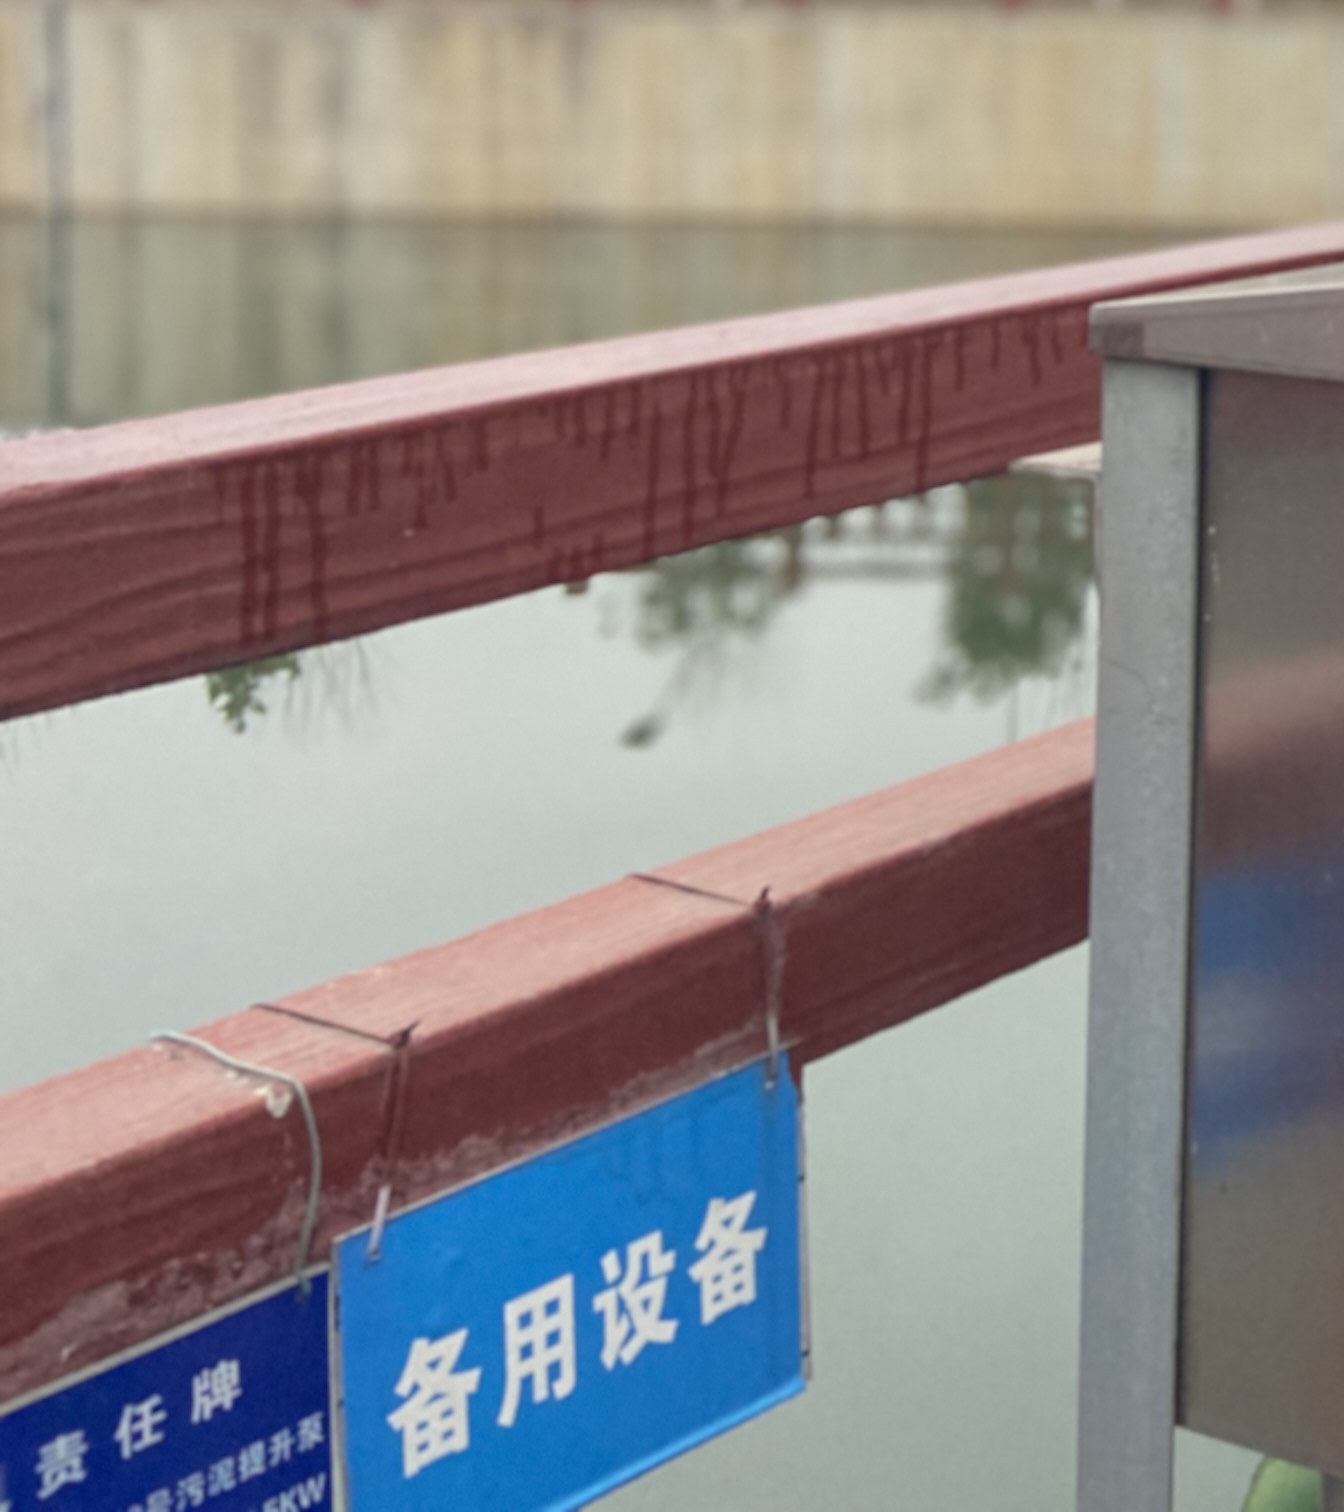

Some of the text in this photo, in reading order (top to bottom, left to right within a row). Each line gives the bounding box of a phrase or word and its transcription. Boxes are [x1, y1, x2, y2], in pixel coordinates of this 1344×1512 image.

[386, 1190, 768, 1479] 备用设备
[0, 1358, 243, 1512] 责任牌
[127, 1410, 325, 1512] 号污泥提升泵
